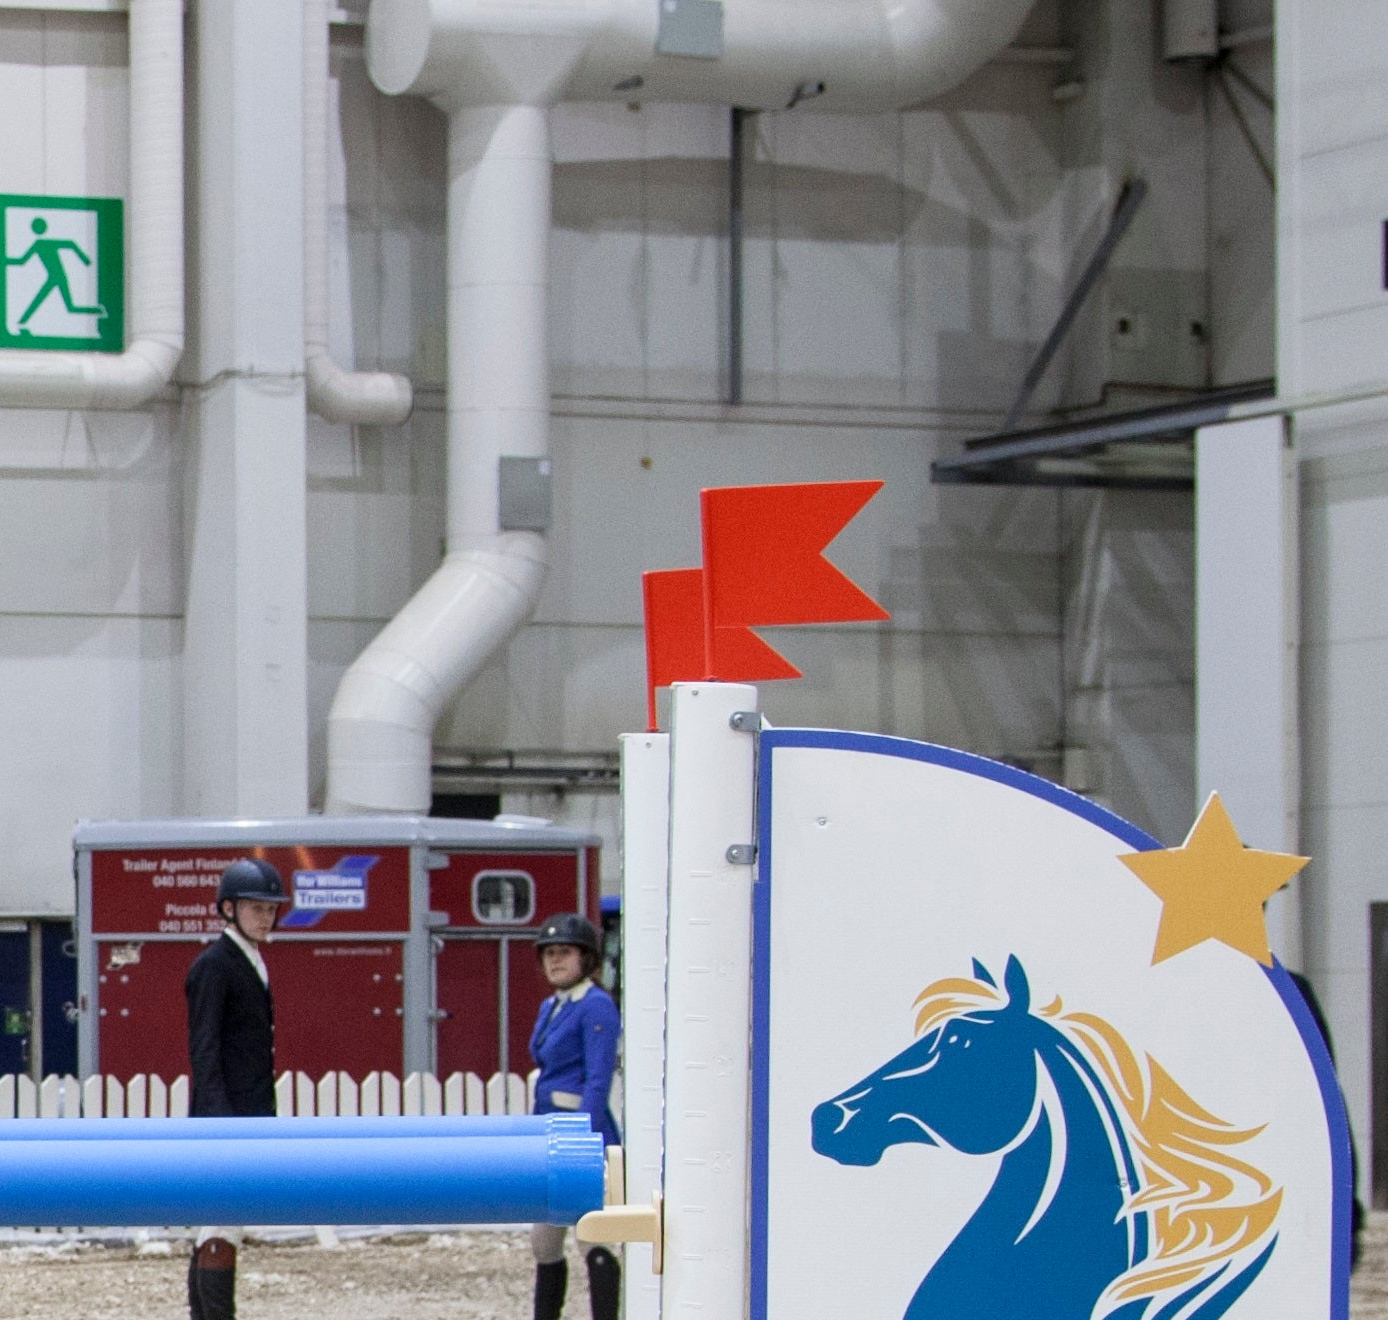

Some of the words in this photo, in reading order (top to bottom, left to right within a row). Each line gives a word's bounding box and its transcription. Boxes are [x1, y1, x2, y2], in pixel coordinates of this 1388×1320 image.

[123, 859, 157, 871] Trailer
[160, 859, 193, 873] Agent
[299, 892, 361, 904] Trailers
